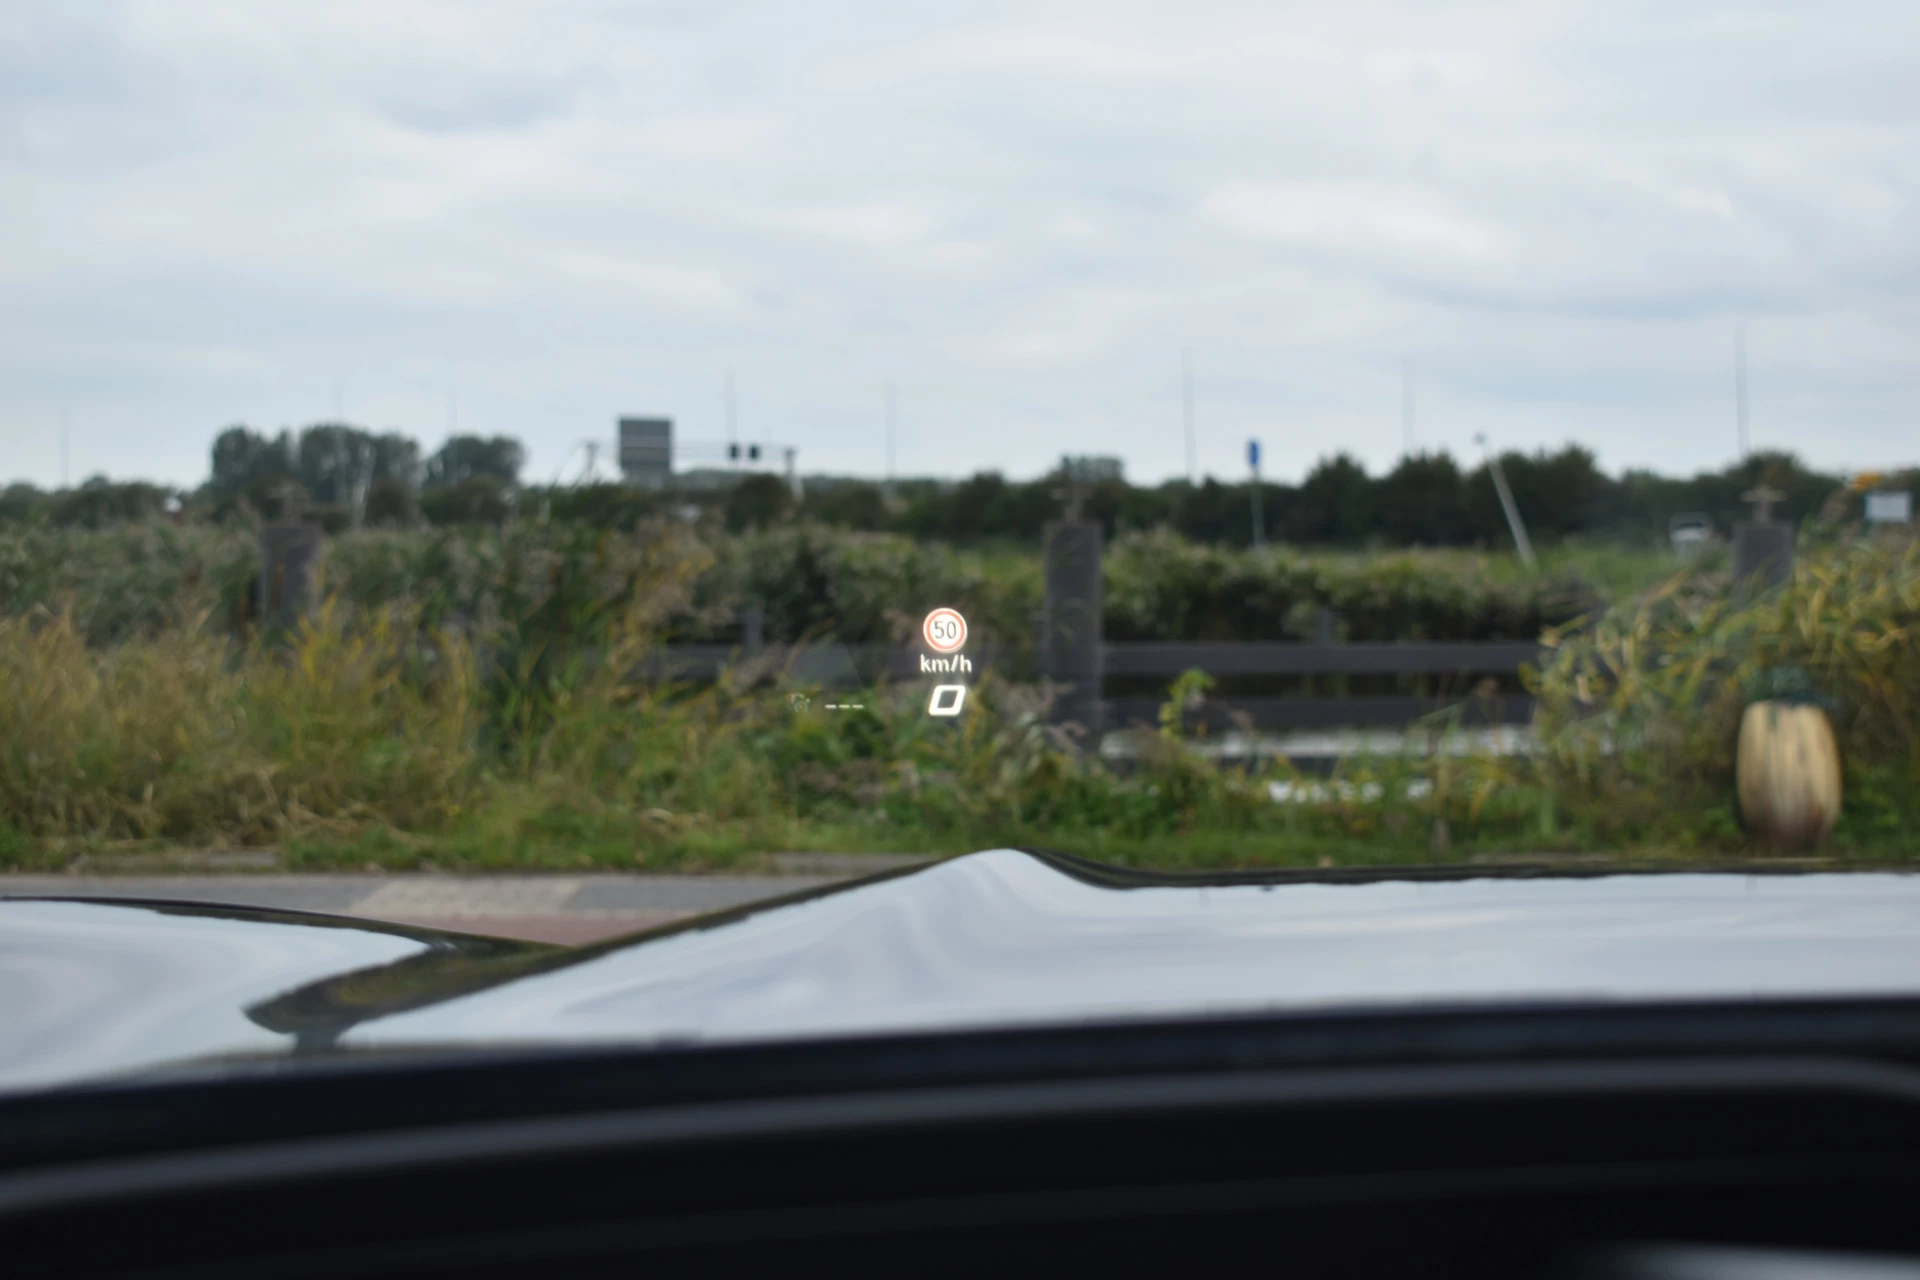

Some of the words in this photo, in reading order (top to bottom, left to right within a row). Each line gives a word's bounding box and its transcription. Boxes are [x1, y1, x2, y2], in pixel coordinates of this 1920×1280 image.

[934, 620, 957, 639] 50
[920, 653, 972, 673] km/h
[928, 684, 966, 716] 0
